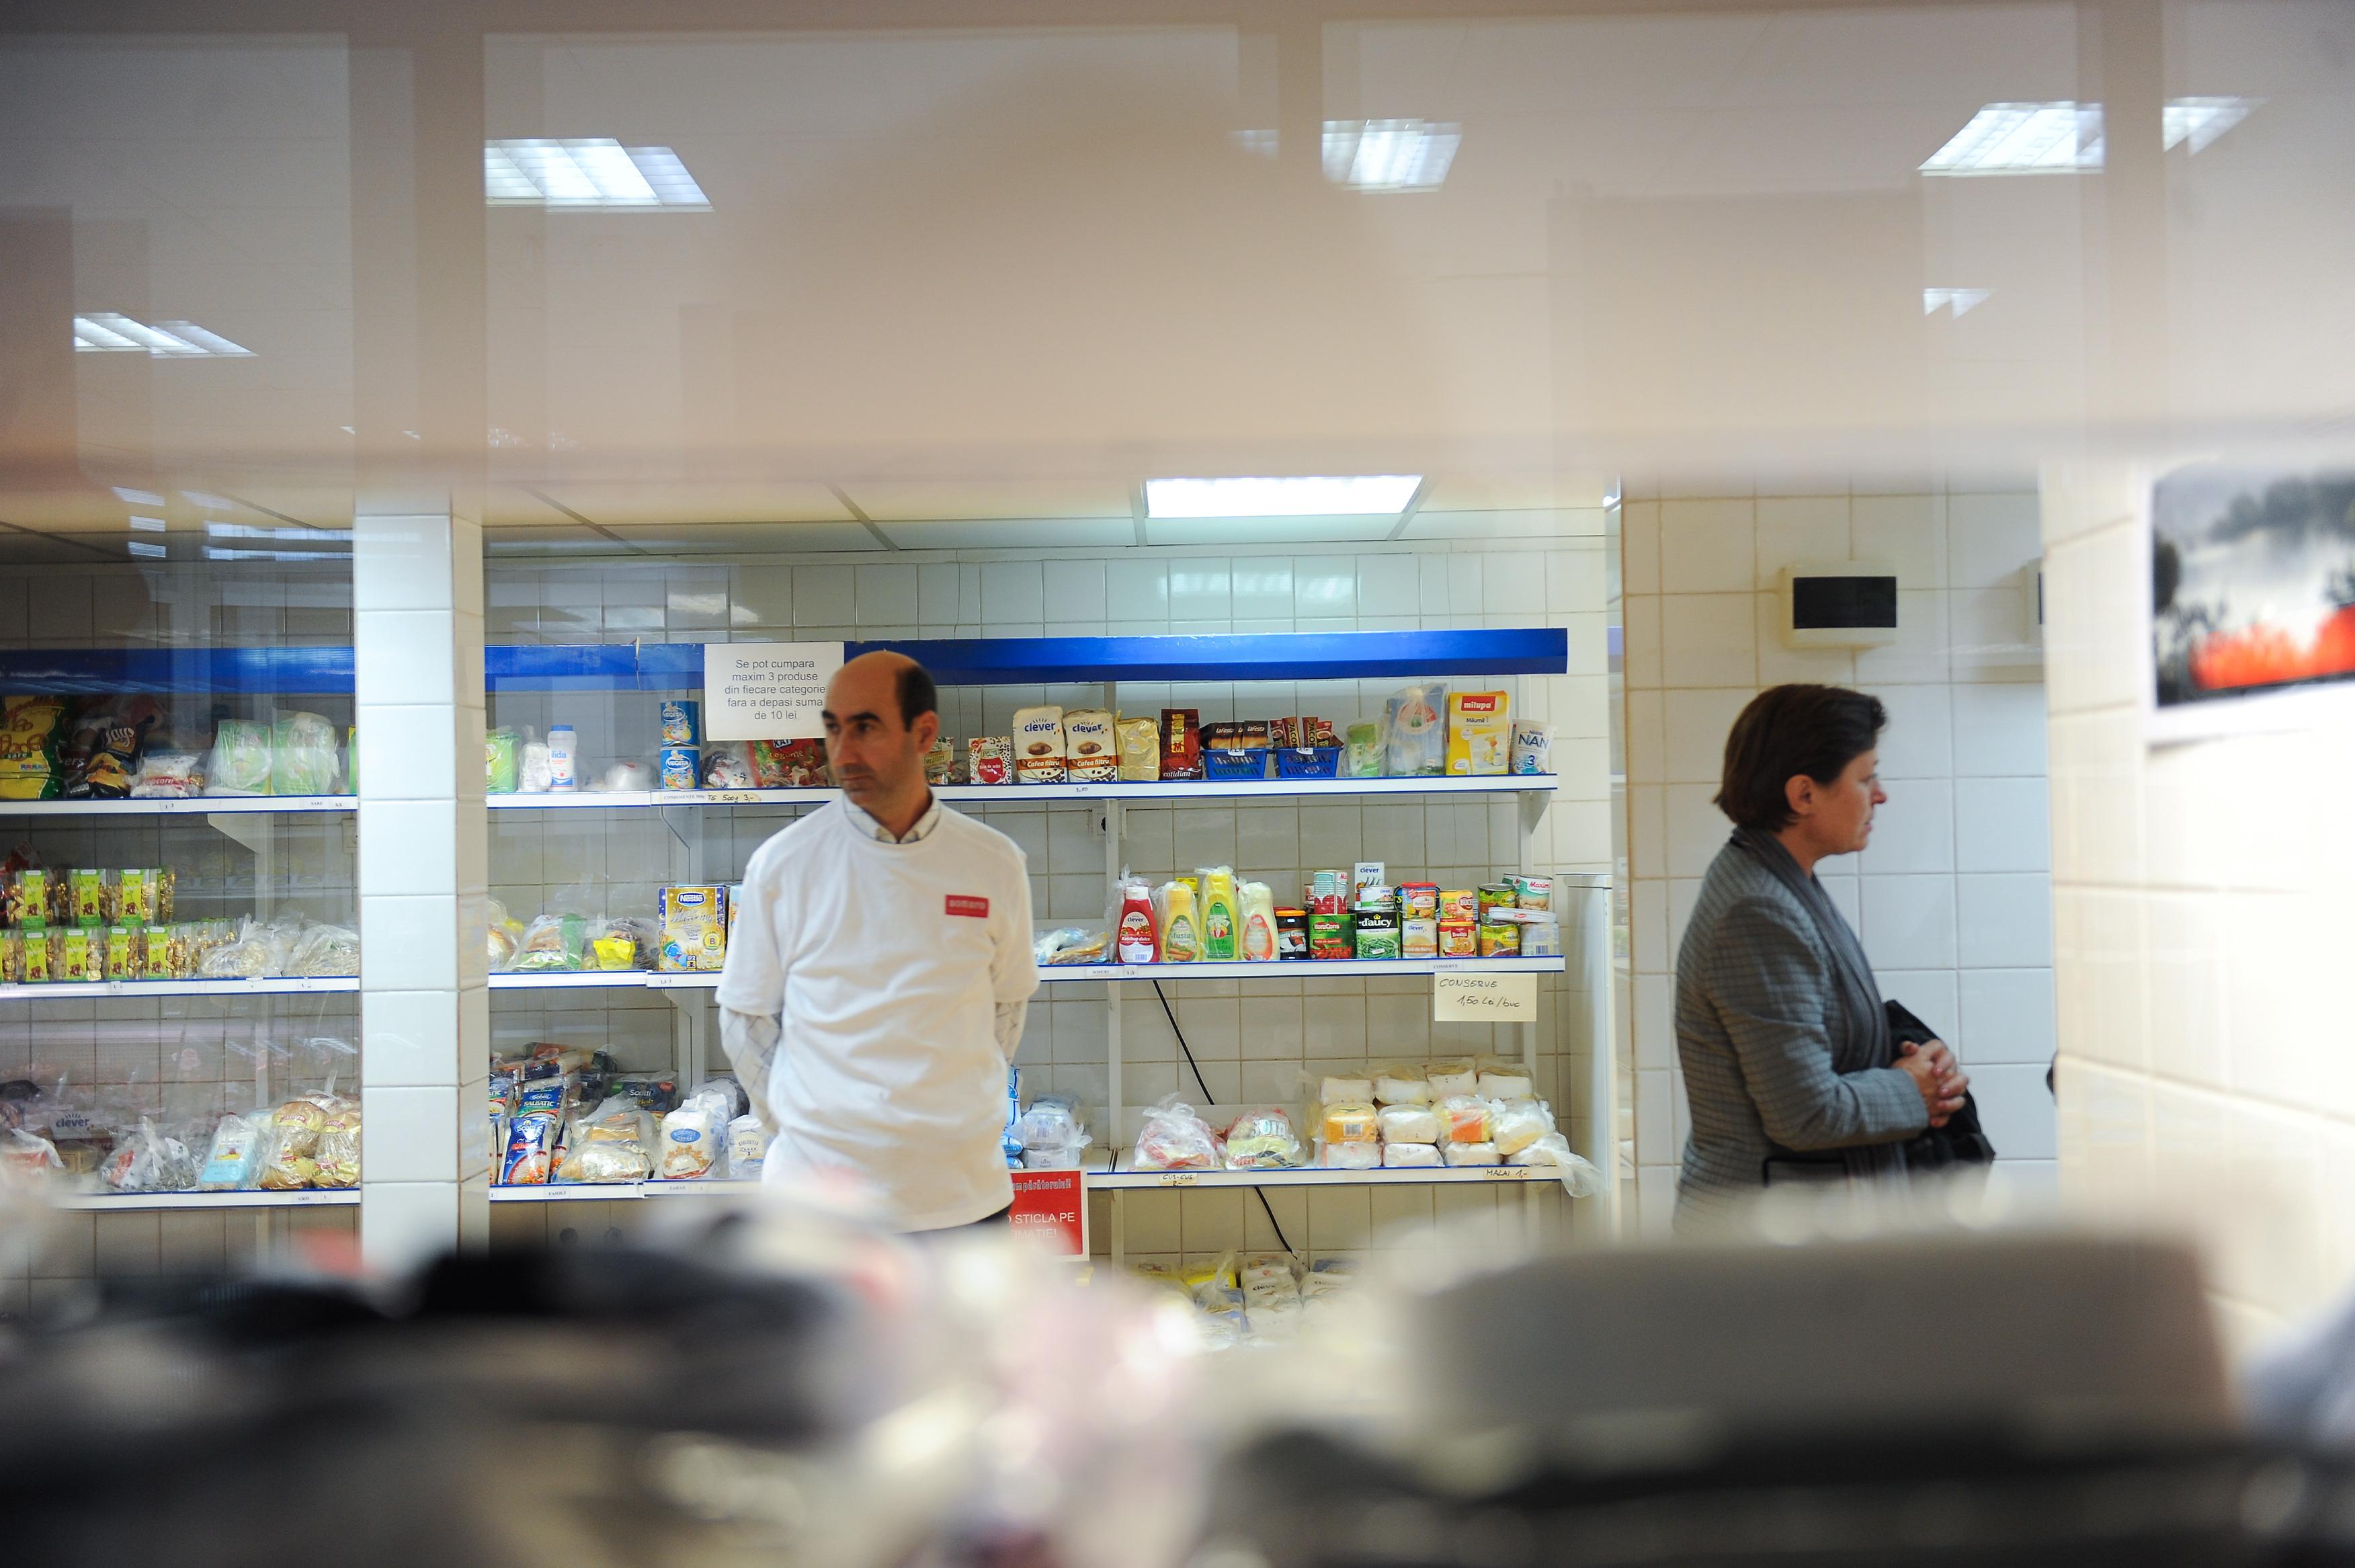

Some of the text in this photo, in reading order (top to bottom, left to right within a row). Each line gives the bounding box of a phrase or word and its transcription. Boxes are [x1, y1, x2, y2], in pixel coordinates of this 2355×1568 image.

[736, 659, 815, 669] Se pot cumpara
[732, 671, 818, 682] maxim 3 produse
[725, 685, 825, 695] din fiecare categorie
[728, 698, 747, 707] fara
[759, 698, 792, 708] depasi
[795, 698, 823, 706] suma
[1463, 701, 1491, 710] milupa
[754, 710, 796, 720] de 10 lei
[1024, 722, 1056, 732] clever
[1072, 723, 1102, 733] clever
[1518, 734, 1549, 749] NAN
[770, 750, 804, 759] Legume
[1044, 760, 1060, 768] filtru
[1094, 759, 1110, 767] filtru
[1528, 755, 1536, 766] 3
[1163, 770, 1191, 778] cotidian
[1440, 979, 1497, 988] CONSERVE
[1457, 995, 1479, 1006] 1,50
[56, 1118, 90, 1127] clever
[1015, 1212, 1075, 1223] STICLA PE
